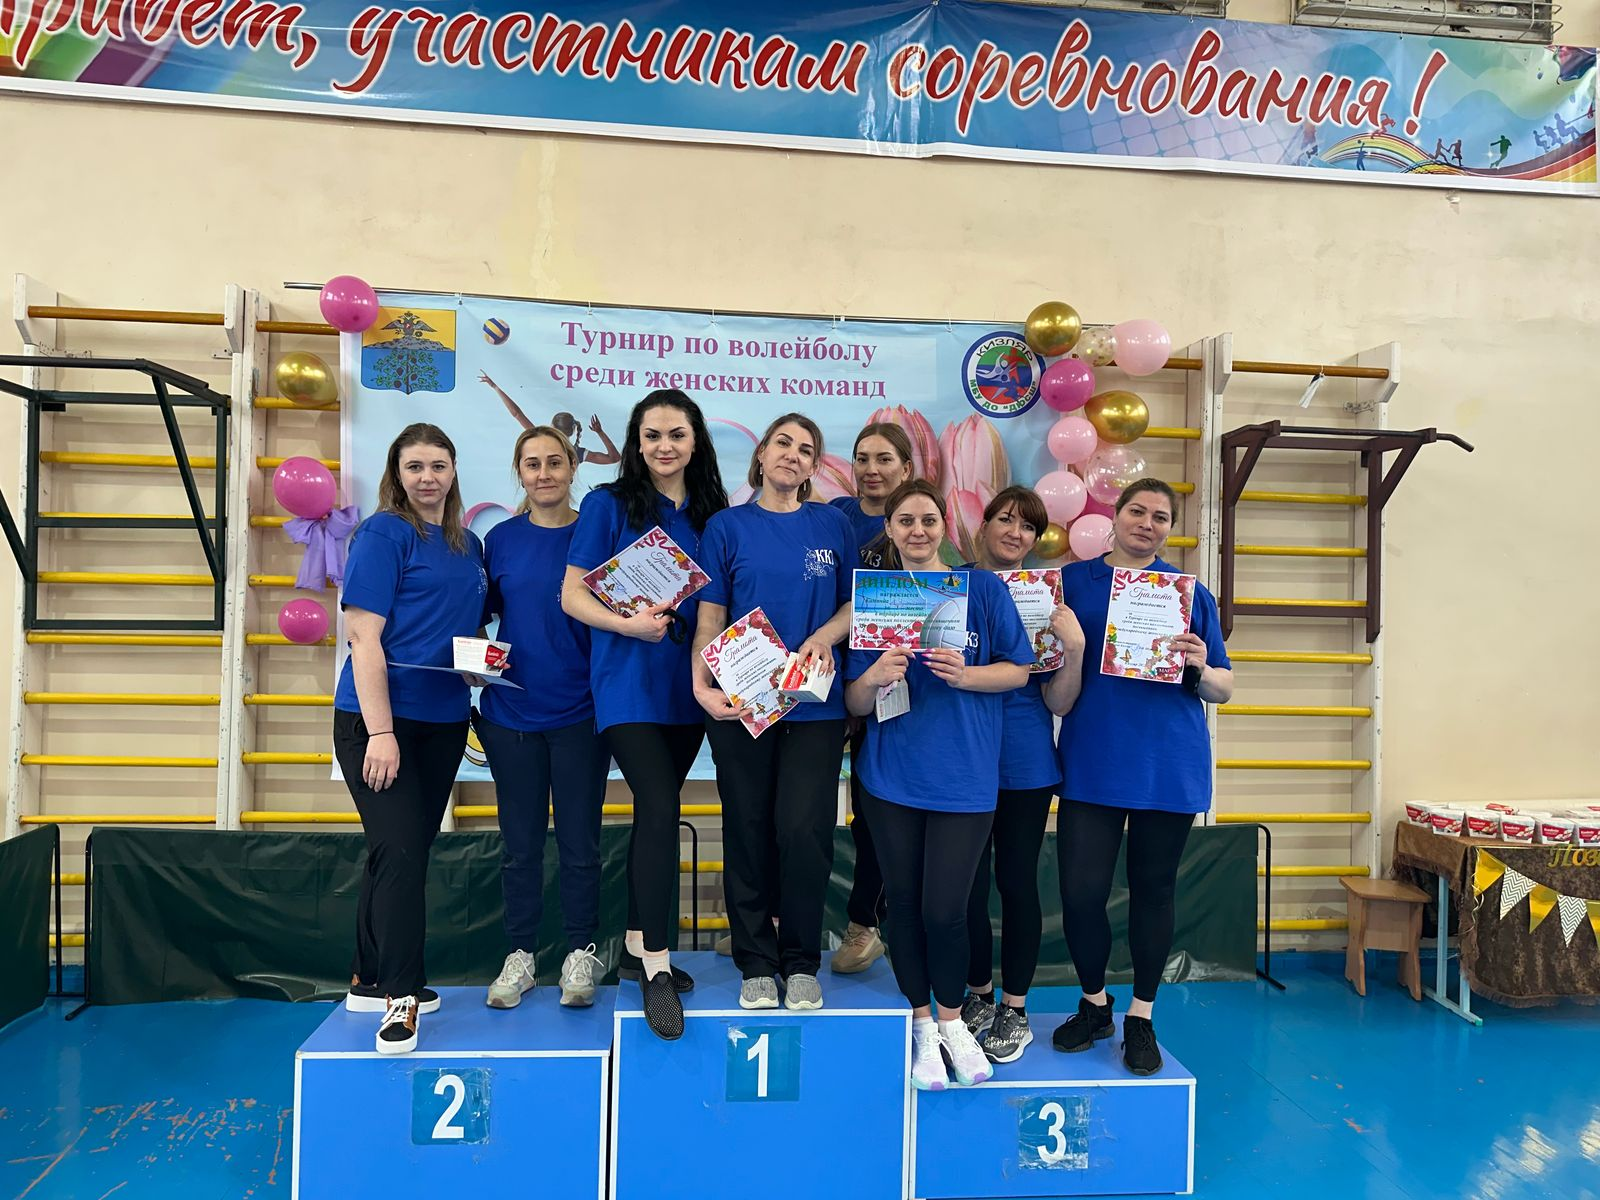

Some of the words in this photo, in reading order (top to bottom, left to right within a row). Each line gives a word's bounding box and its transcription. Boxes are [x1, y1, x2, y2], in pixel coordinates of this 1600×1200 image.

[0, 0, 318, 68] ривет,
[335, 3, 868, 93] участникам
[561, 321, 674, 358] Турнир
[684, 337, 719, 355] по
[728, 336, 878, 367] волейболу
[976, 338, 1033, 361] КИЗЛЯР
[550, 363, 635, 388] среди
[645, 370, 771, 394] женских
[781, 378, 886, 399] команд
[969, 379, 983, 400] МБУ
[982, 401, 999, 411] ДО
[1129, 587, 1173, 600] Грамота
[747, 1033, 769, 1097] 1
[431, 1074, 466, 1139] 2
[1037, 1102, 1067, 1164] 3
